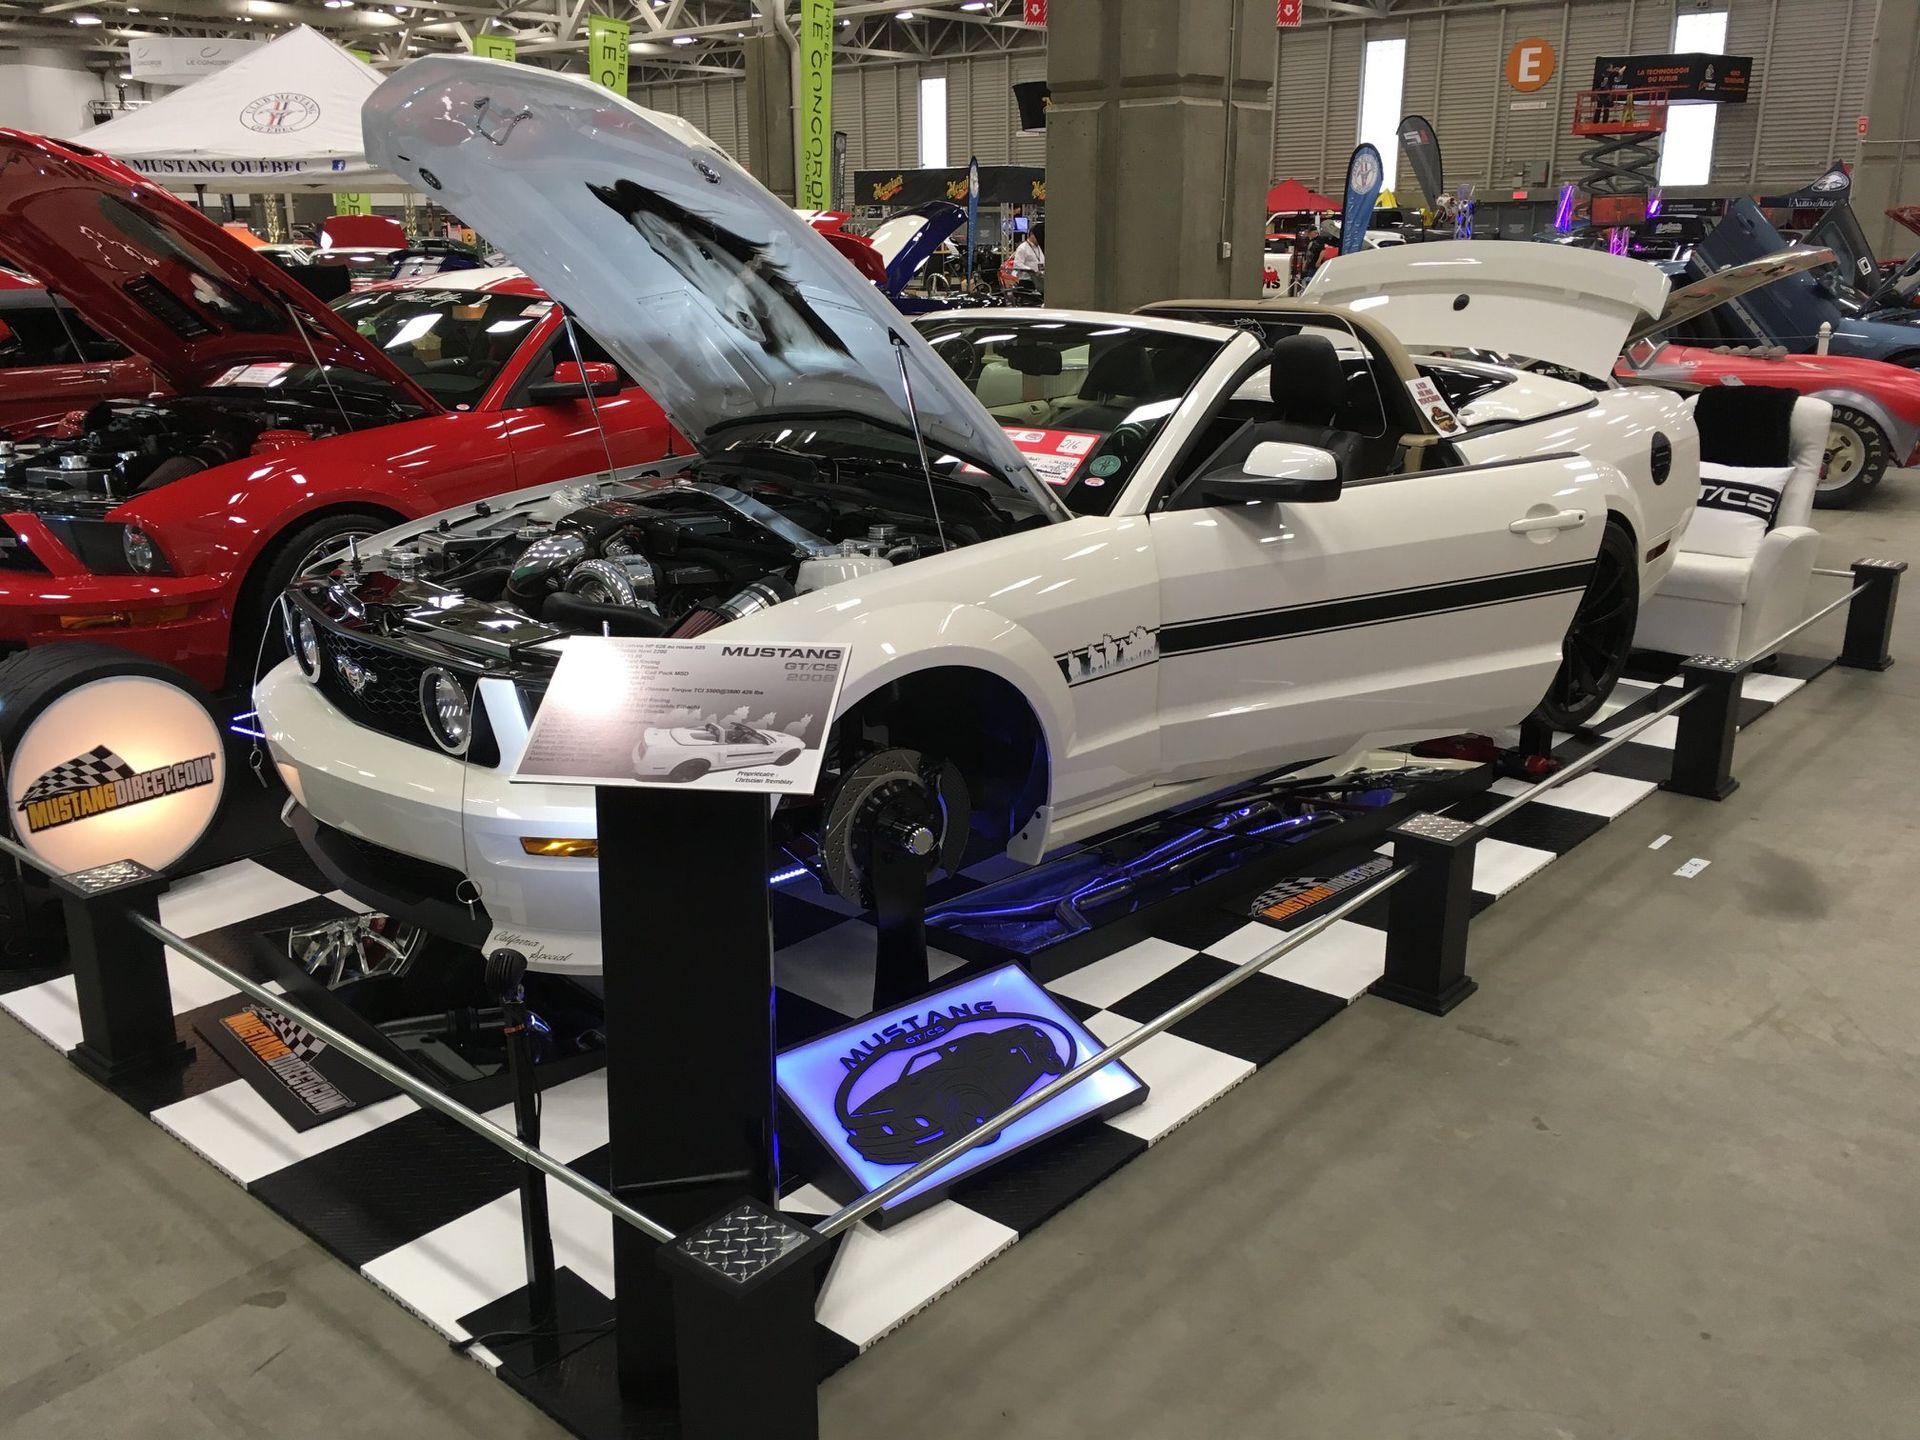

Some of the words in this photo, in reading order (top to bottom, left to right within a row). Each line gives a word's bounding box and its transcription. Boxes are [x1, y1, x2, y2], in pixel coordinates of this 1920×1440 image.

[813, 3, 824, 40] LE
[602, 29, 617, 61] LE
[617, 32, 628, 80] HOTEL
[1518, 47, 1542, 83] E
[134, 159, 225, 173] MUSTANG
[231, 157, 307, 174] QUÉBEC
[1699, 484, 1775, 513] T/CS
[721, 646, 842, 660] MUSTANG
[784, 662, 838, 672] GT/CS
[26, 756, 214, 833] MUSTANGDIRECT.COM
[493, 930, 540, 947] California
[528, 945, 574, 961] Special
[839, 1001, 998, 1072] MUSTANG
[904, 1025, 946, 1045] GT/CS
